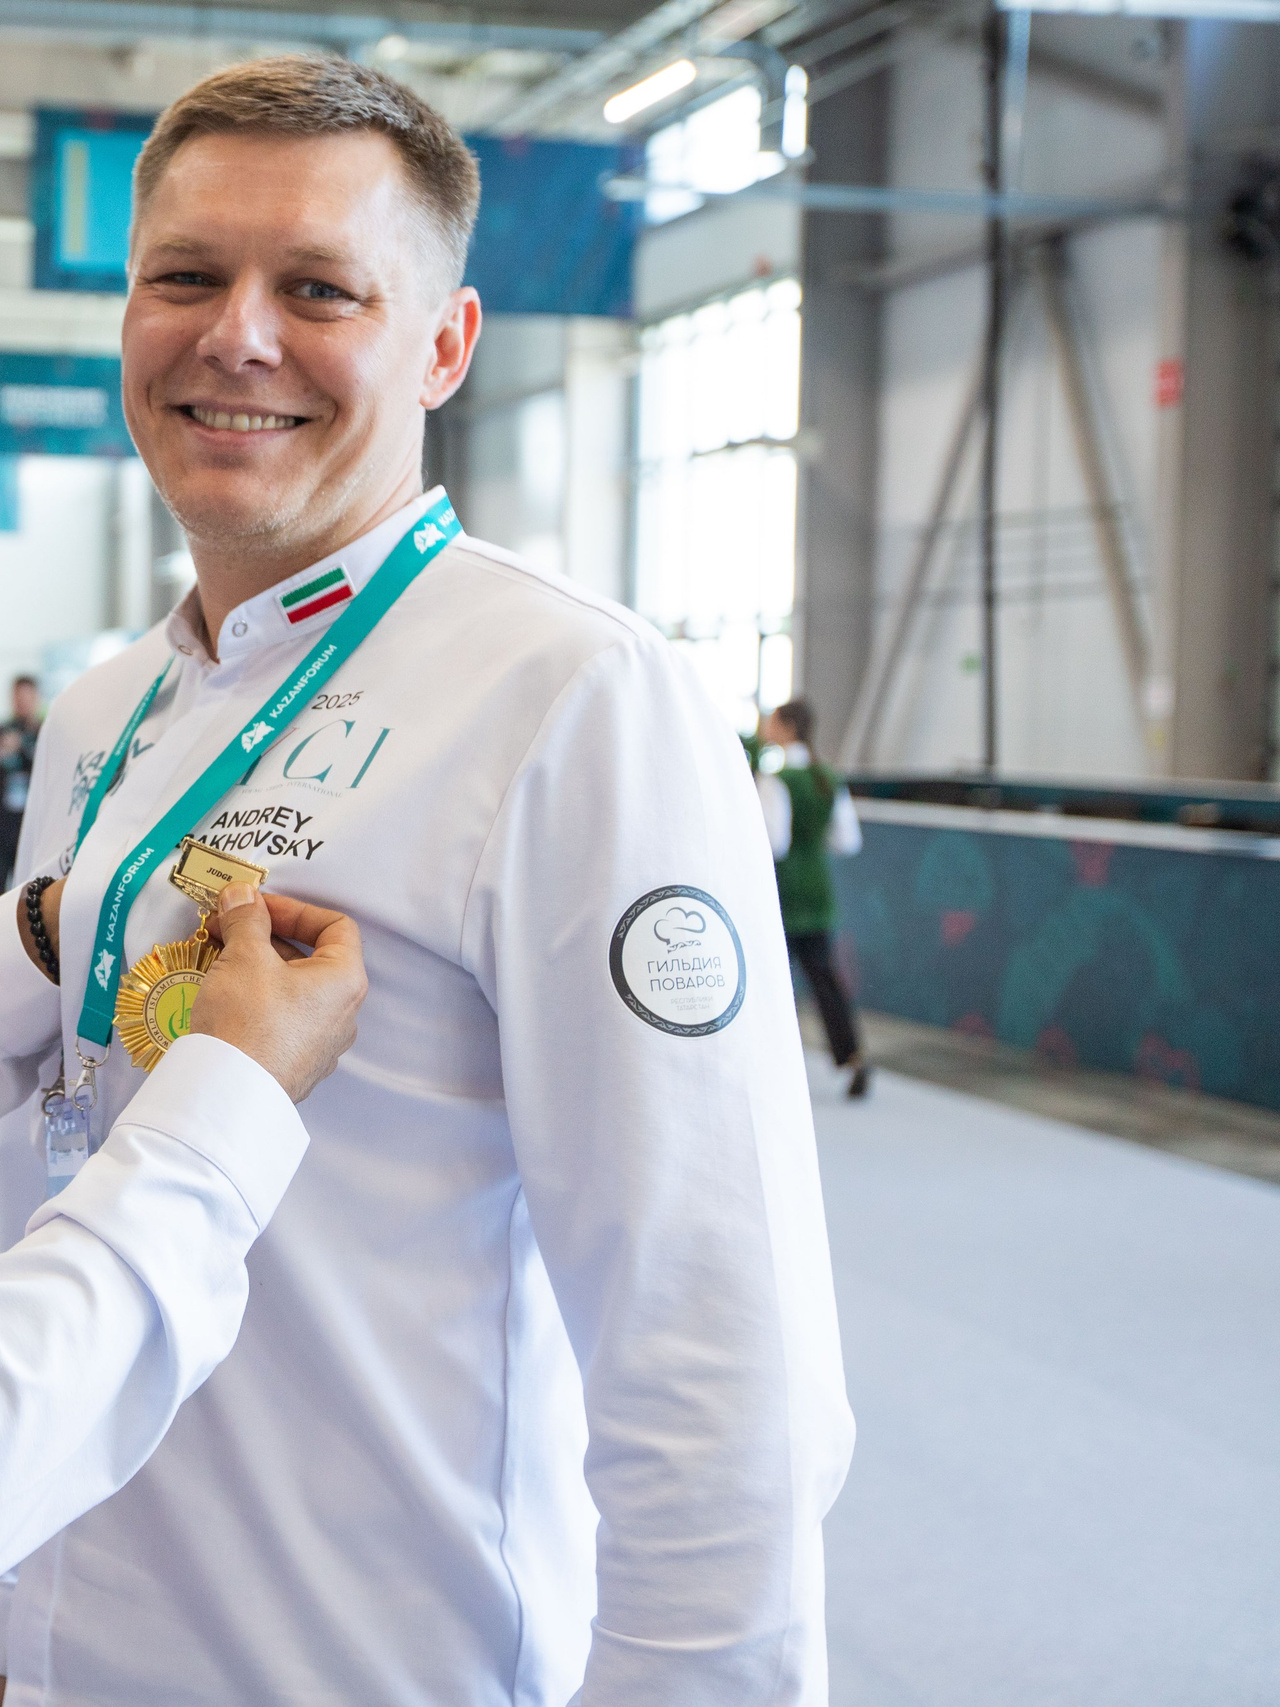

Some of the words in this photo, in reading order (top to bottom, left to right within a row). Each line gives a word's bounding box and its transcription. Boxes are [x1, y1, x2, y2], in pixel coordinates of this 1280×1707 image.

[269, 644, 338, 718] KAZANFORUM
[311, 690, 365, 710] 2025
[210, 806, 313, 833] ANDREY
[206, 867, 233, 882] JUDGE
[106, 847, 155, 942] KAZANFORUM
[647, 957, 722, 974] ГИЛЬДИЯ
[183, 975, 201, 984] CHE
[650, 975, 726, 992] ПОВАРОВ
[149, 978, 176, 1010] ISLAMIC
[149, 1018, 169, 1047] WORLD
